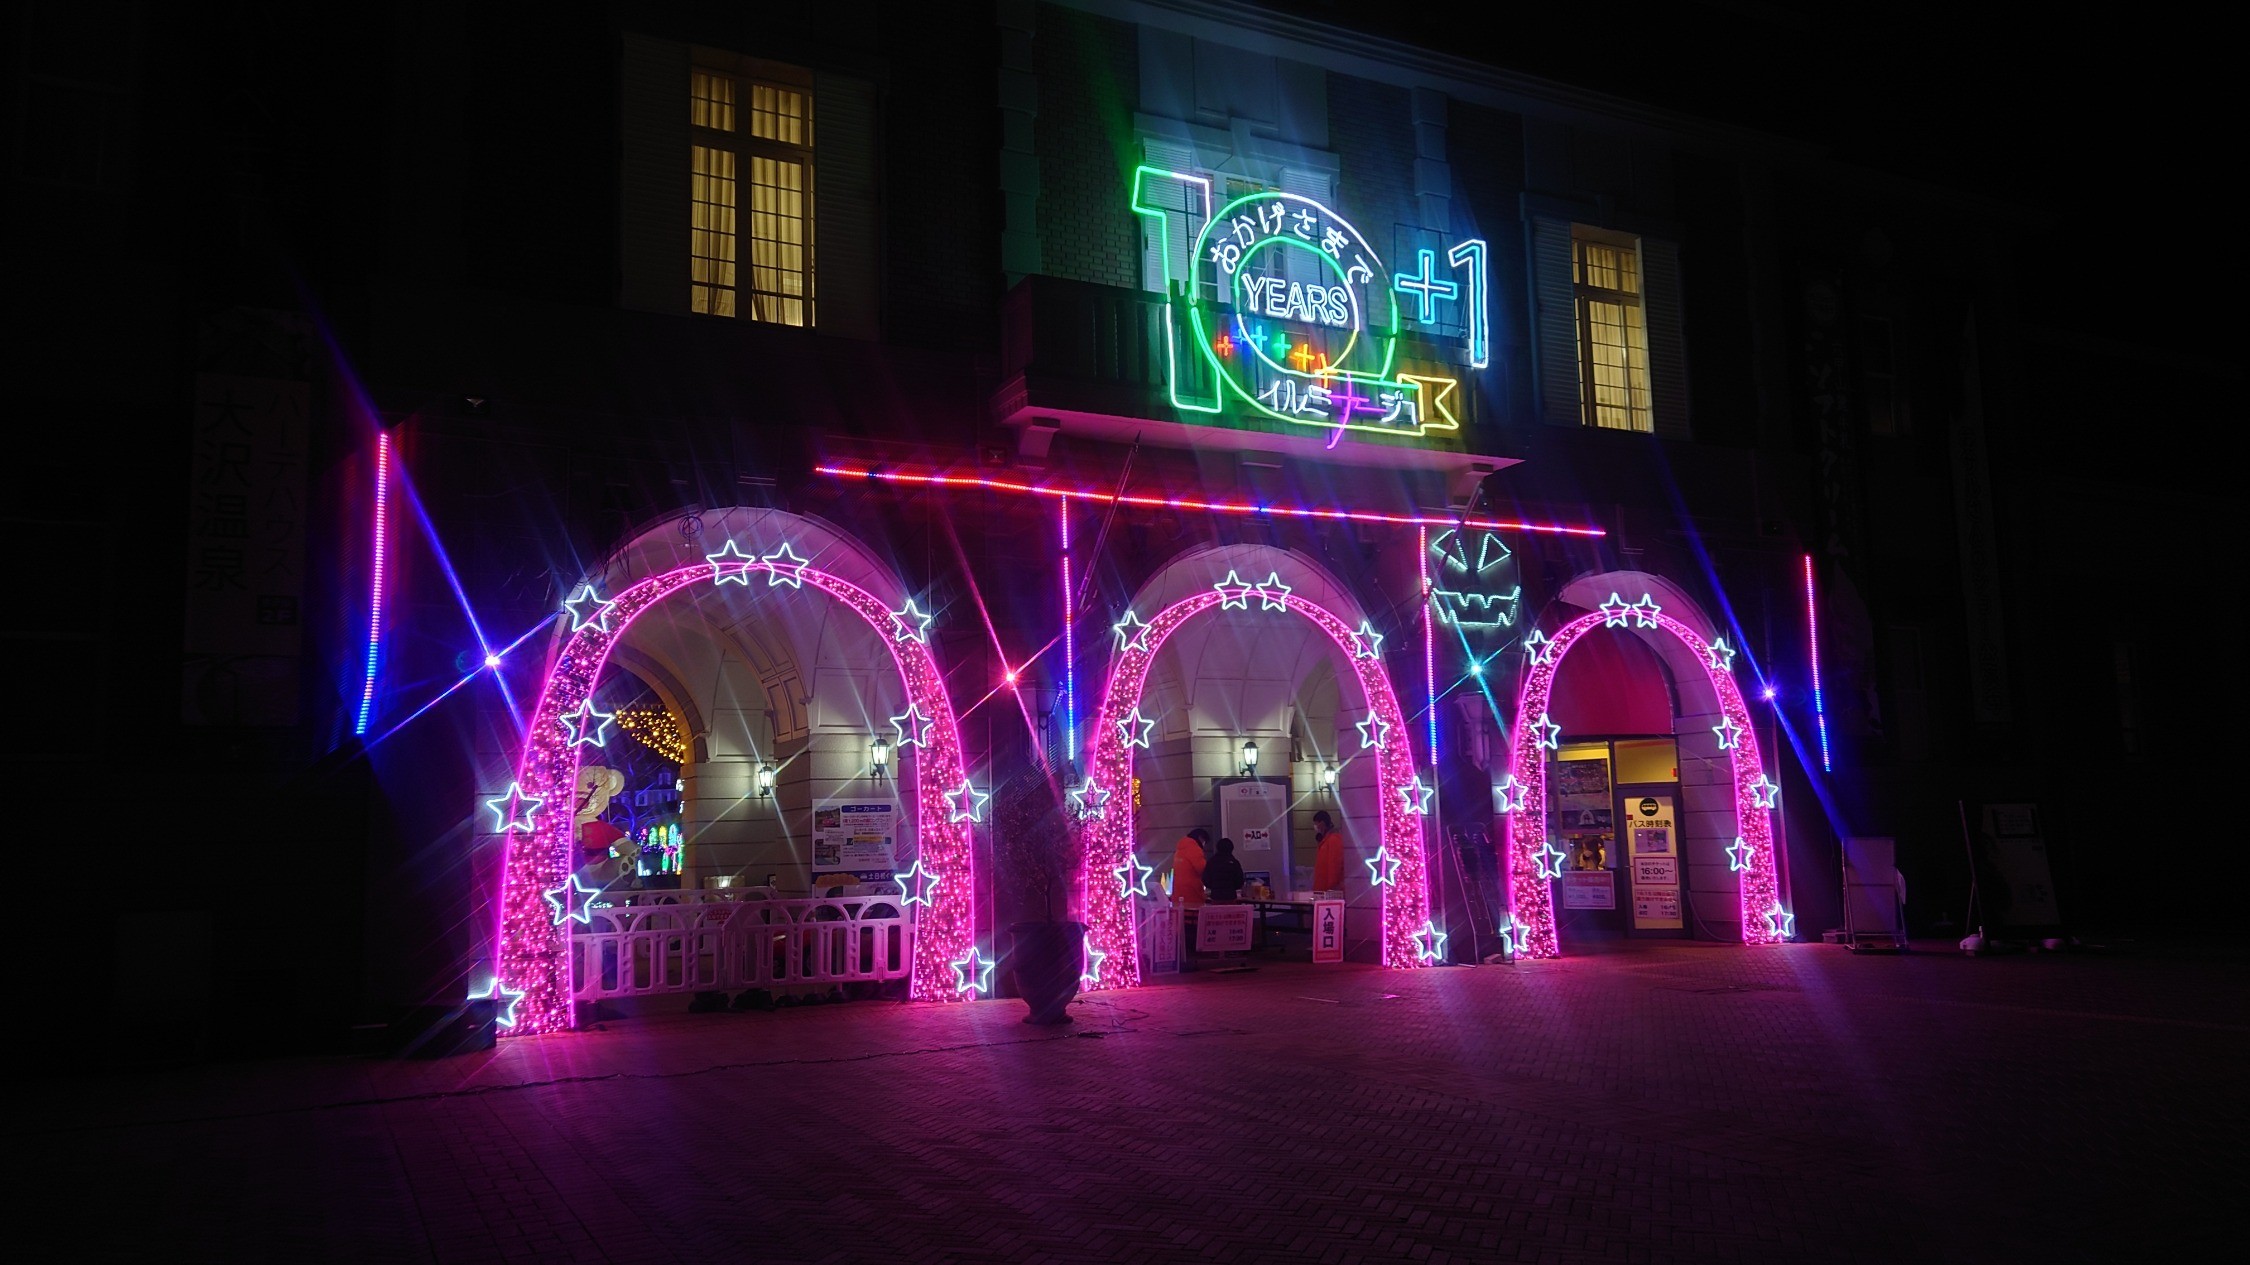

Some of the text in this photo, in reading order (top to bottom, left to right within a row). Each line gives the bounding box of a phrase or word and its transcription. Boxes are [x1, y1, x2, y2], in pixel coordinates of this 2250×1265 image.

[1209, 200, 1374, 286] おかげさまで
[1240, 272, 1349, 326] YEARS
[194, 389, 255, 592] 大沢温泉
[1250, 830, 1262, 840] 入口
[1629, 819, 1672, 828] バス時刻表
[1322, 907, 1335, 949] 入場口
